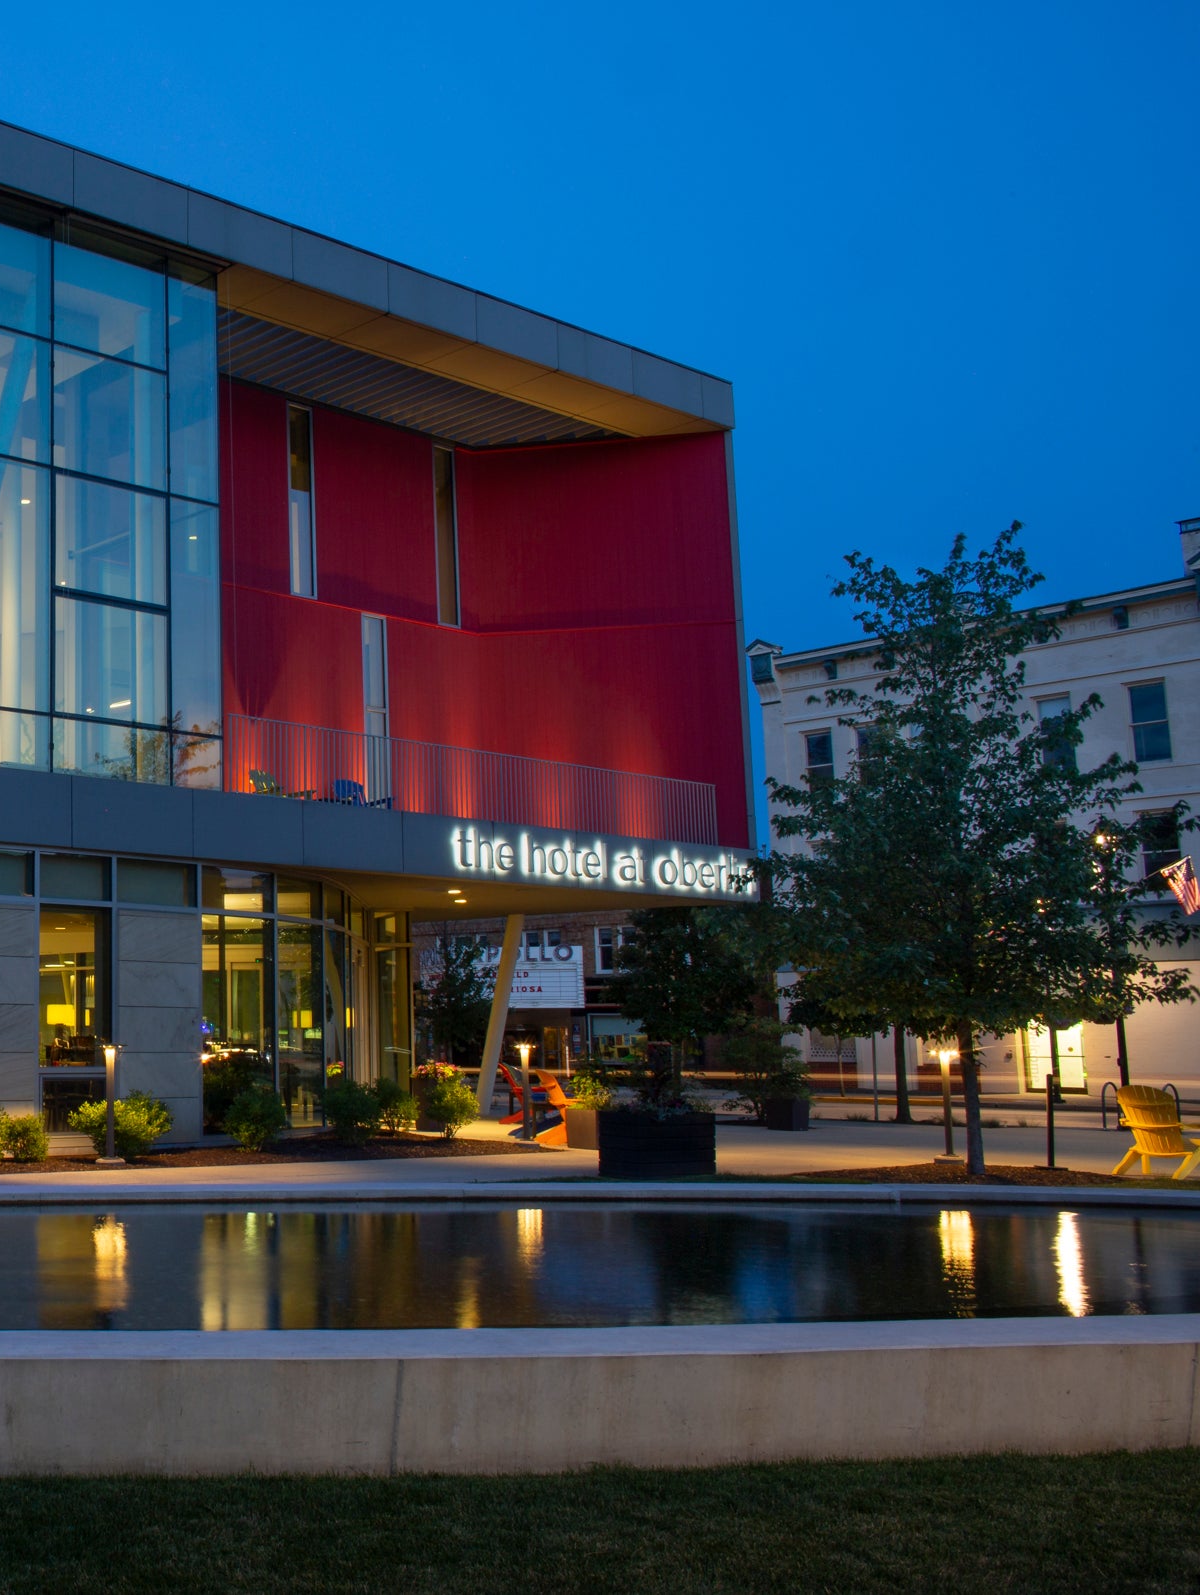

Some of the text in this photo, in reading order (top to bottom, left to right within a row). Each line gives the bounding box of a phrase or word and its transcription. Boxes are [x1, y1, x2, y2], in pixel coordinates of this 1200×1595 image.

[455, 829, 514, 871] the
[526, 832, 608, 879] hotel
[618, 848, 648, 883] at
